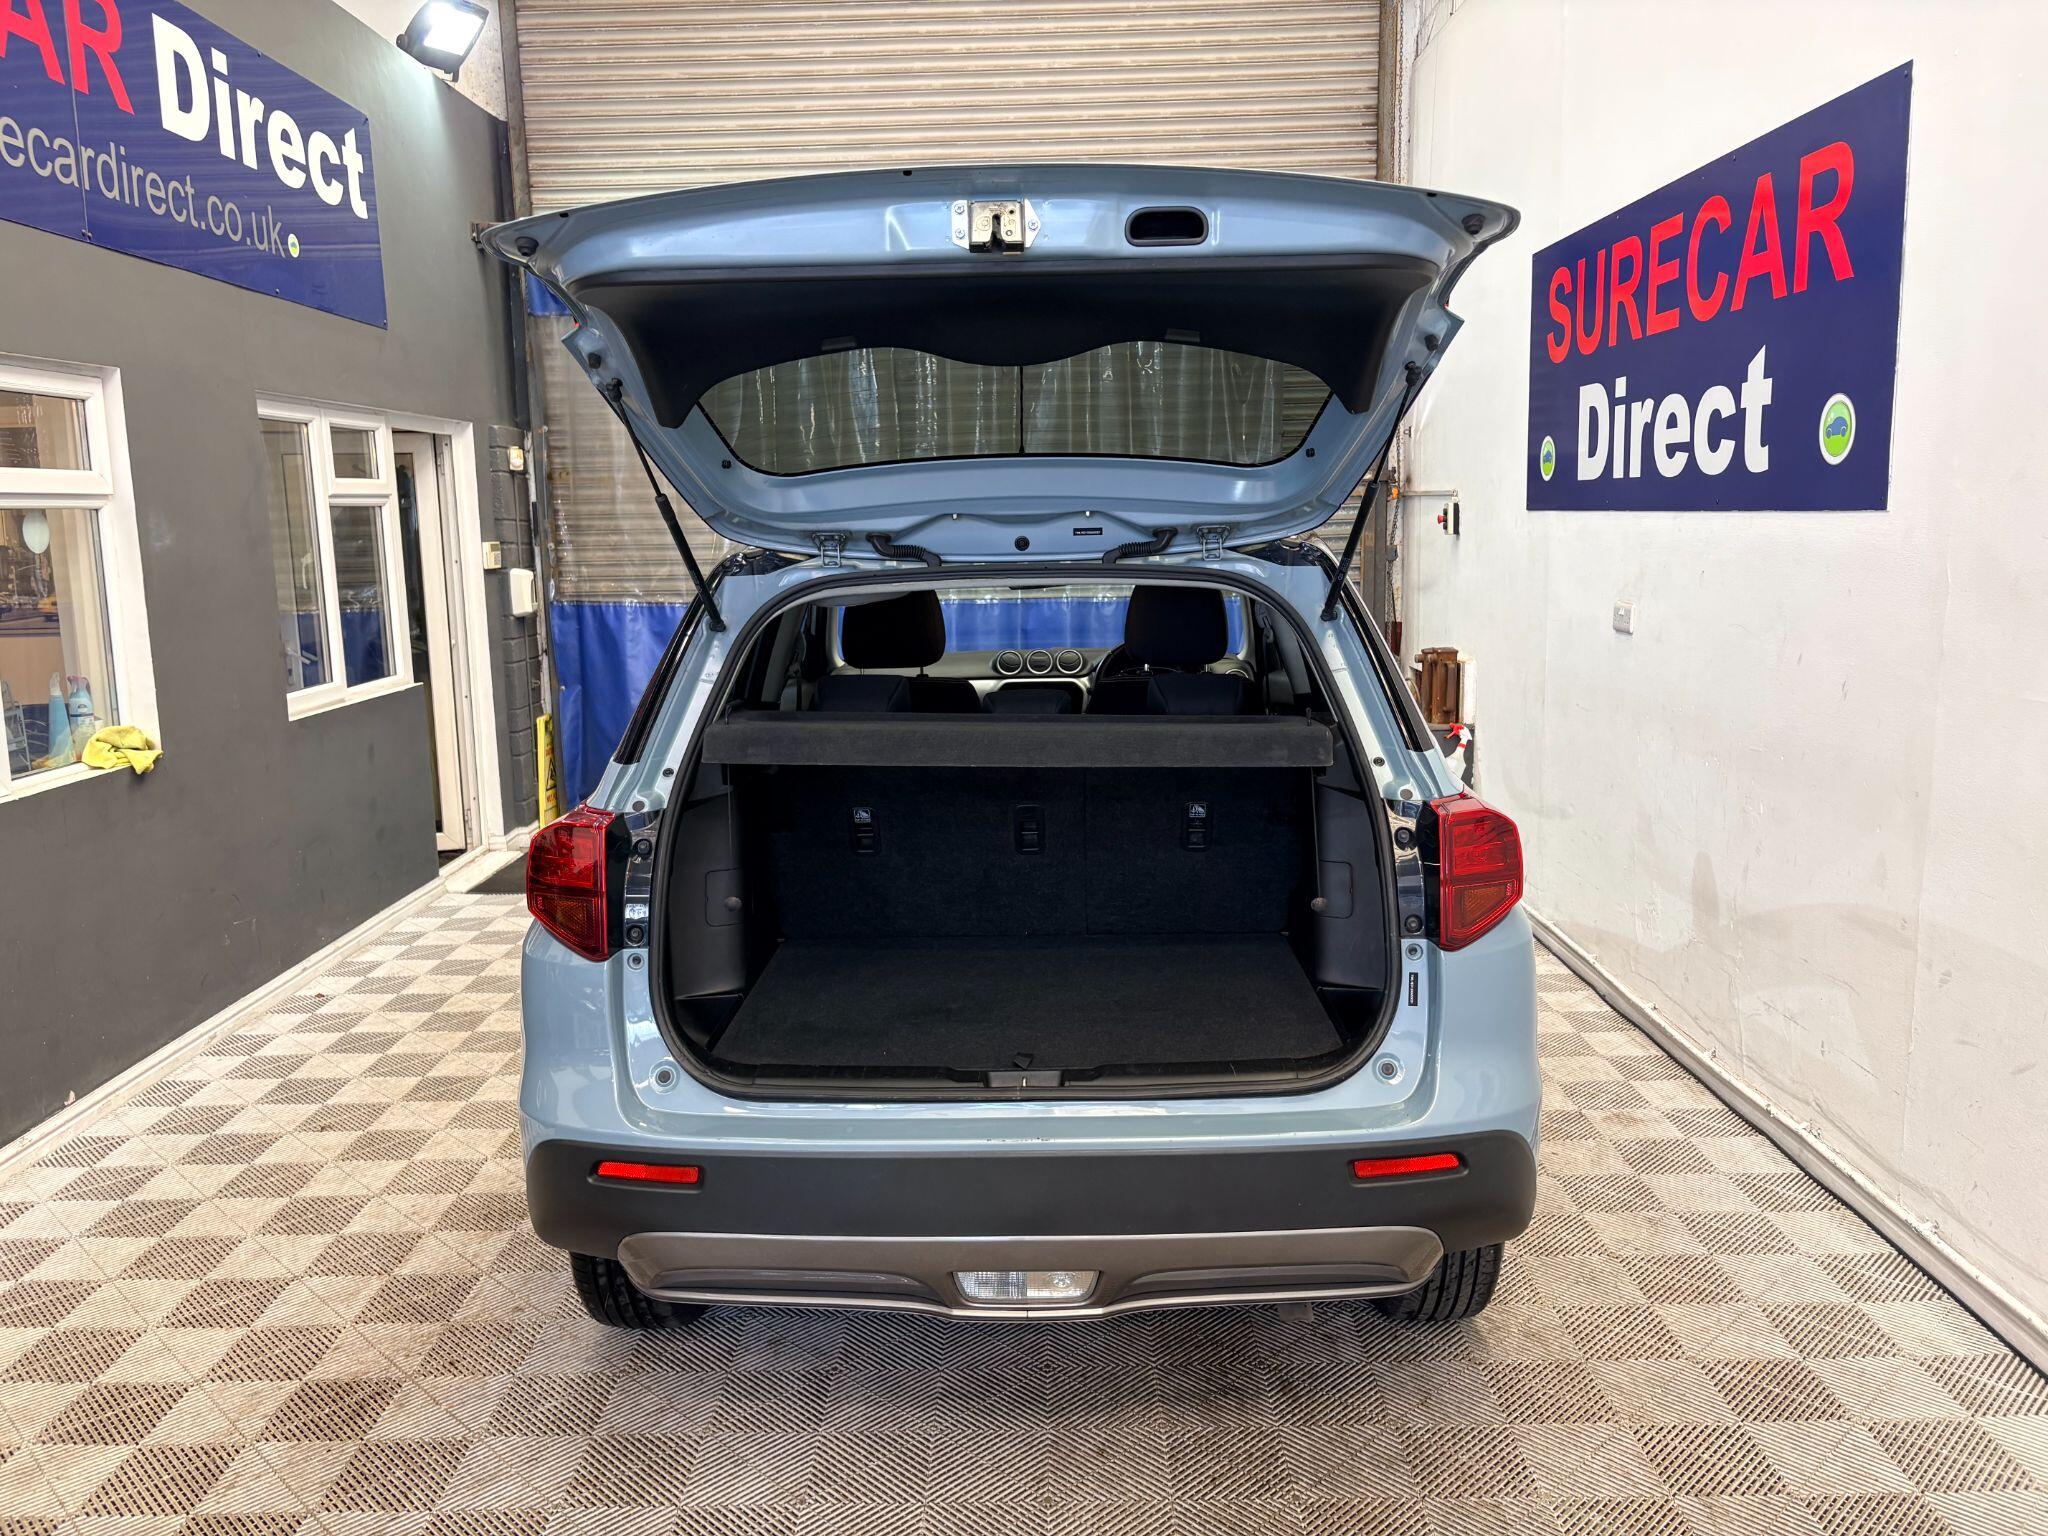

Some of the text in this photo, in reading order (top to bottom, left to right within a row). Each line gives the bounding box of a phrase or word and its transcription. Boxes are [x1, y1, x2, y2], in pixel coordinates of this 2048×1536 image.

[0, 116, 286, 258] ecardirect.co.uk
[152, 13, 369, 219] Direct
[1547, 141, 1855, 364] SURECAR
[1577, 344, 1773, 481] Direct
